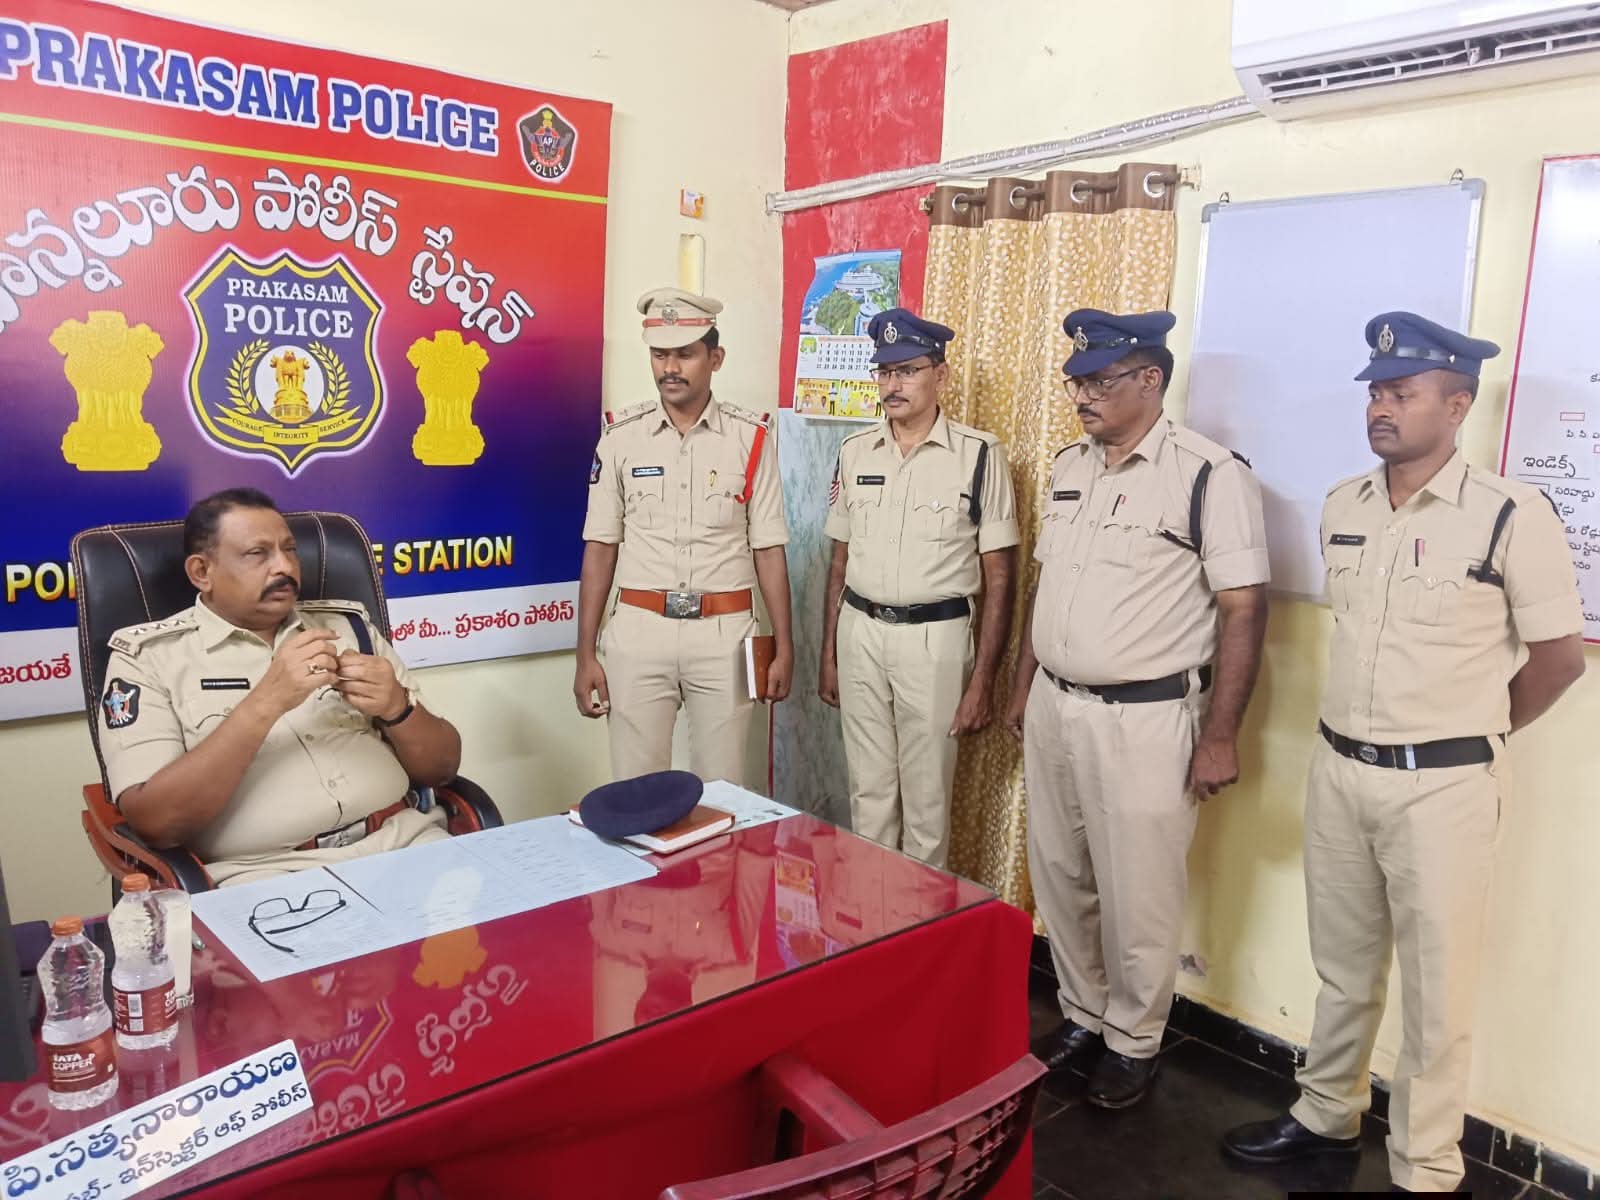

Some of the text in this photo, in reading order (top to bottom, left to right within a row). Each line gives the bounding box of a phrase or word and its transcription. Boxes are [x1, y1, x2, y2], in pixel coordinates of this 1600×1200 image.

[0, 23, 499, 154] PRAKASAM POLICE
[543, 137, 552, 145] AP
[530, 159, 565, 176] POLICE
[253, 167, 399, 257] పోలీస్
[408, 225, 536, 345] స్టేషన్
[226, 277, 348, 305] PRAKASAM
[224, 304, 354, 339] POLICE
[232, 418, 346, 440] COURAGE INTEGRITY SERVICE
[393, 535, 513, 575] STATION
[455, 608, 520, 639] ప్రకాశం
[524, 600, 574, 626] పోలీస్
[53, 1053, 82, 1063] TATA
[214, 1110, 247, 1138] ఆఫ్
[252, 1082, 308, 1122] పోలీస్
